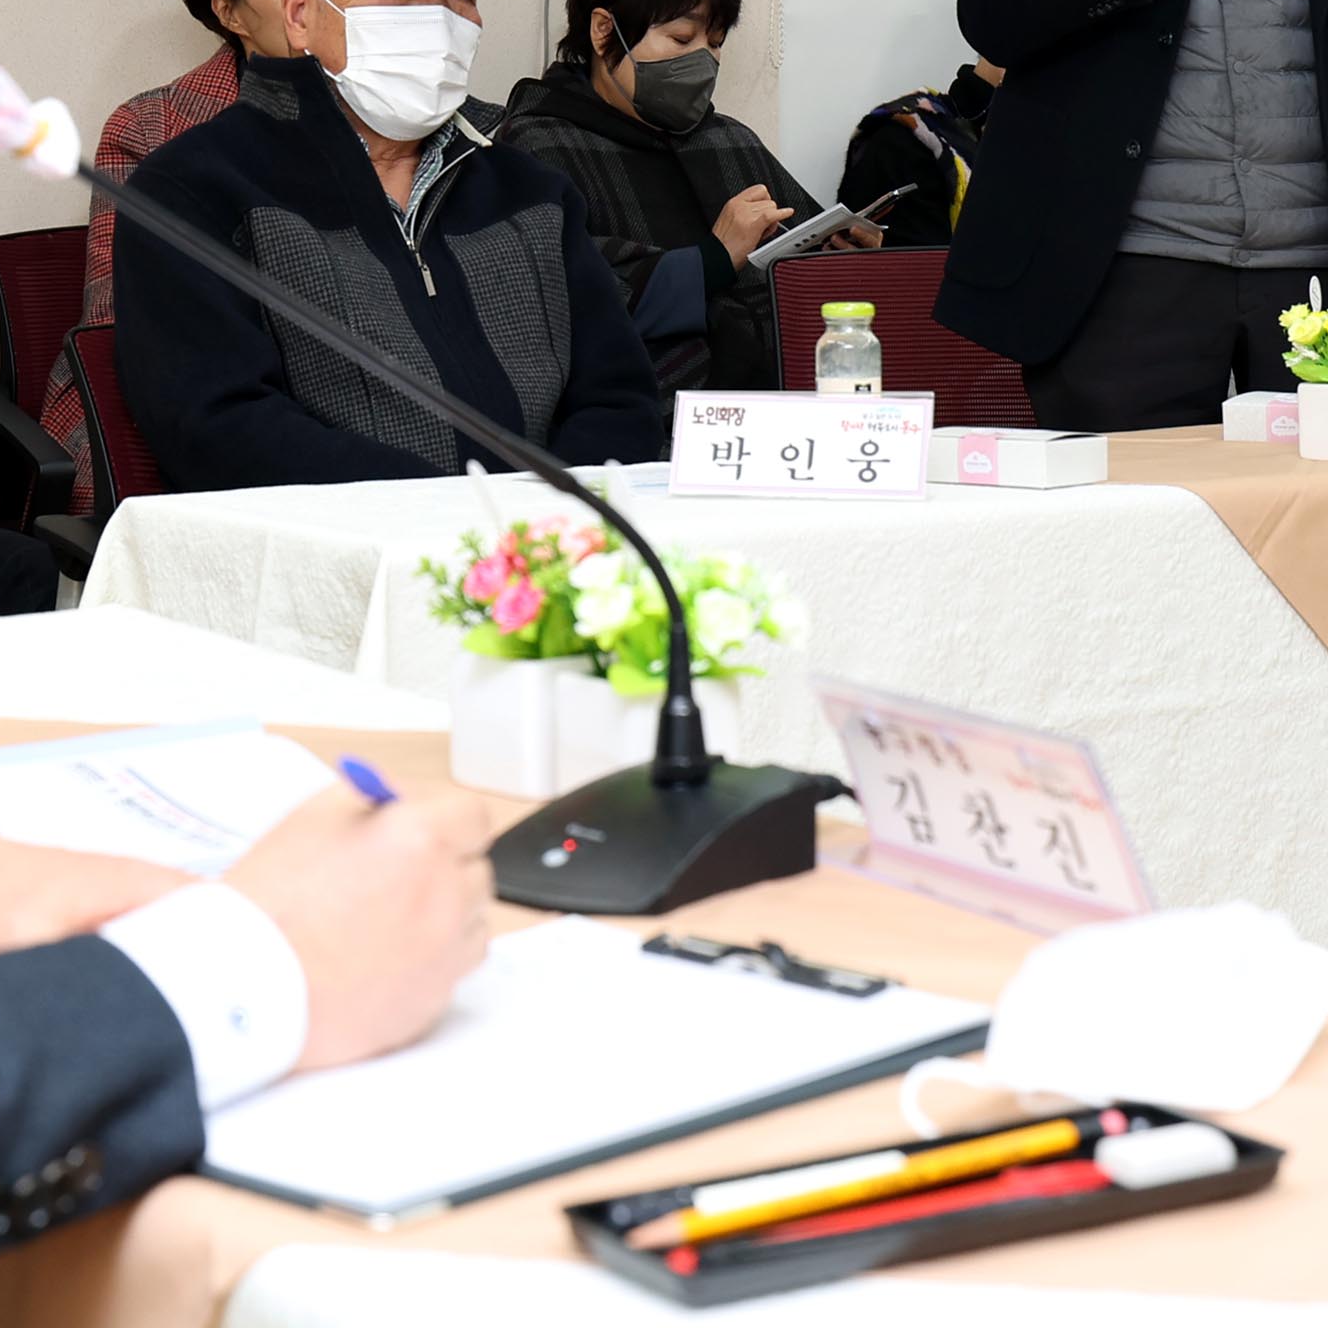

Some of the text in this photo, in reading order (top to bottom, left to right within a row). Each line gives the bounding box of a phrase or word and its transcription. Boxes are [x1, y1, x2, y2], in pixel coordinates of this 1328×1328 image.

[692, 406, 746, 427] 노인회장
[711, 436, 891, 483] 박인웅
[885, 770, 1098, 892] 김찬진
